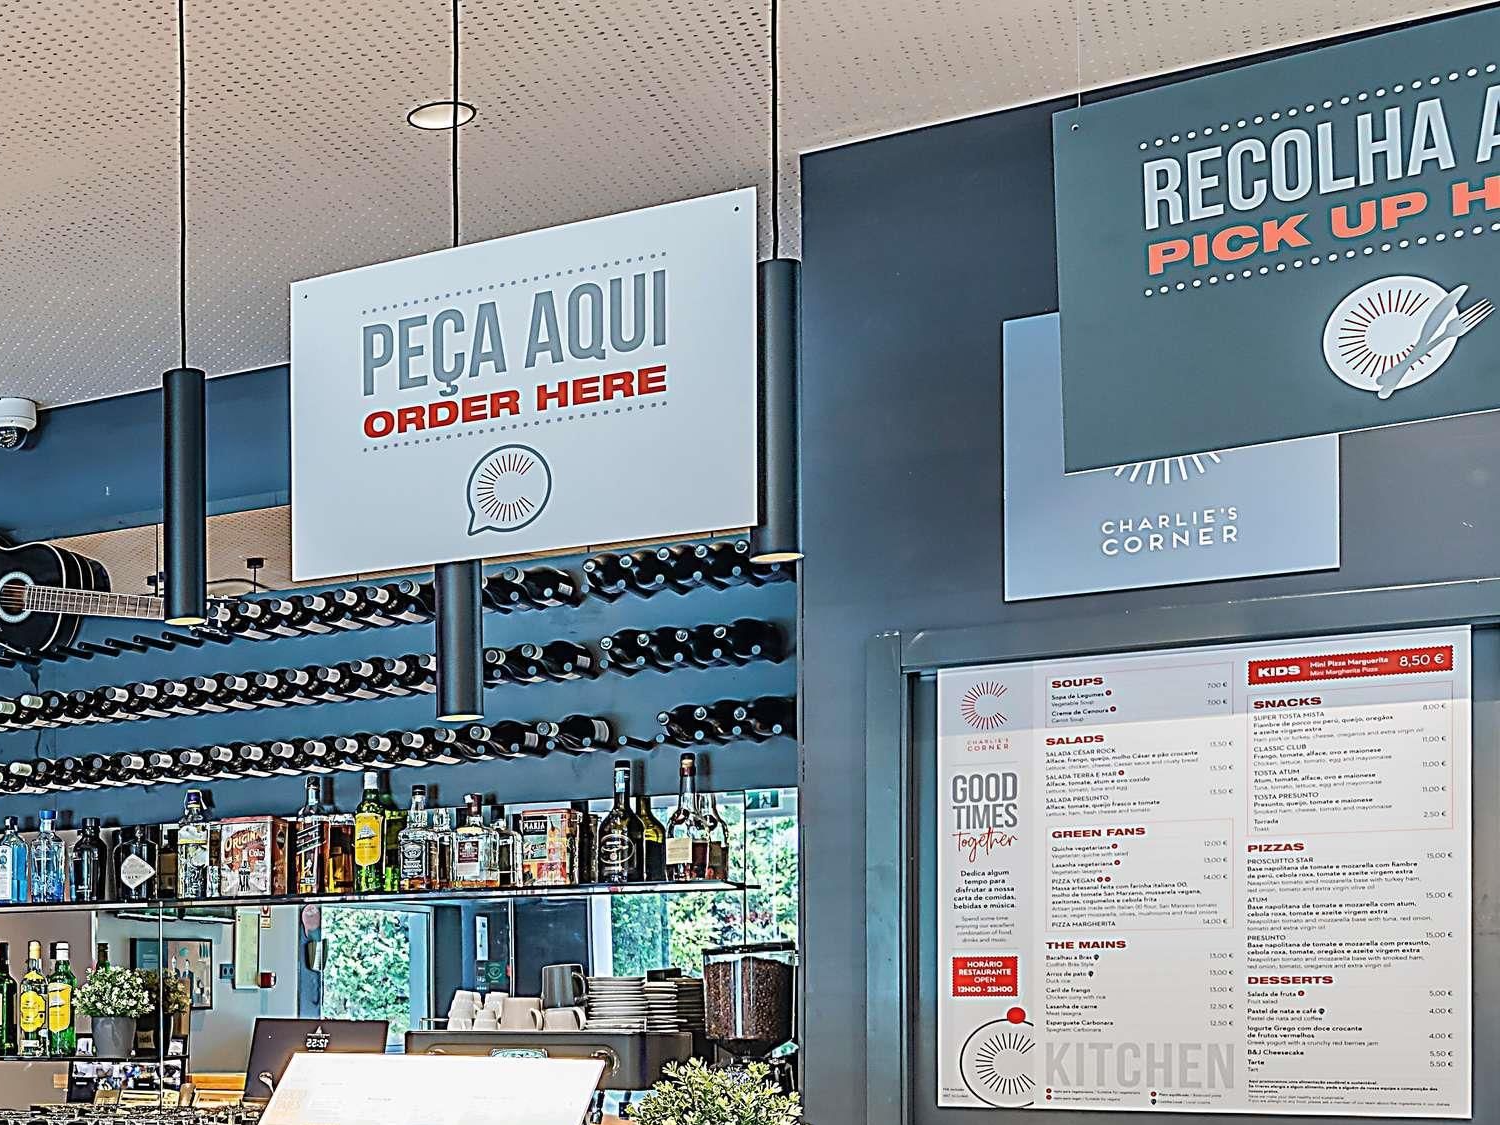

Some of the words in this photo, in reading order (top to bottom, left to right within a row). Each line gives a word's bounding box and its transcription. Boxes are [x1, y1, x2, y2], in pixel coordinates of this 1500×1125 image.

[1143, 98, 1455, 230] RECOLHA
[1147, 213, 1309, 275] PICK
[1331, 191, 1427, 239] UP
[362, 302, 506, 397] PEÇA
[524, 269, 667, 369] AQUI
[363, 390, 520, 438] ORDER
[536, 365, 667, 411] HERE
[1101, 506, 1239, 535] CHARLIE'S
[1102, 526, 1239, 556] CORNER
[1327, 659, 1346, 667] Pizza
[1347, 656, 1388, 667] Marguerita
[1399, 653, 1430, 668] 8,50
[1434, 652, 1444, 664] €
[1258, 665, 1300, 677] KIDS
[1051, 676, 1103, 689] SOUPS
[1253, 696, 1321, 709] SNACKS
[1045, 734, 1104, 746] SALADS
[967, 742, 1008, 752] CORNER
[1253, 744, 1284, 752] CLASSIC
[952, 771, 1017, 804] GOOD
[1278, 791, 1319, 799] PRESUNTO
[952, 802, 1017, 831] TIMES
[1051, 828, 1101, 839] GREEN
[1106, 826, 1145, 836] FANS
[1247, 842, 1304, 852] PIZZAS
[960, 869, 985, 877] Dedica
[987, 868, 1009, 877] algum
[1045, 941, 1074, 949] THE
[1078, 940, 1126, 949] MAINS
[966, 959, 1003, 968] HORÁRIO
[1247, 975, 1333, 984] DESSERTS
[1045, 1041, 1234, 1090] KITCHEN
